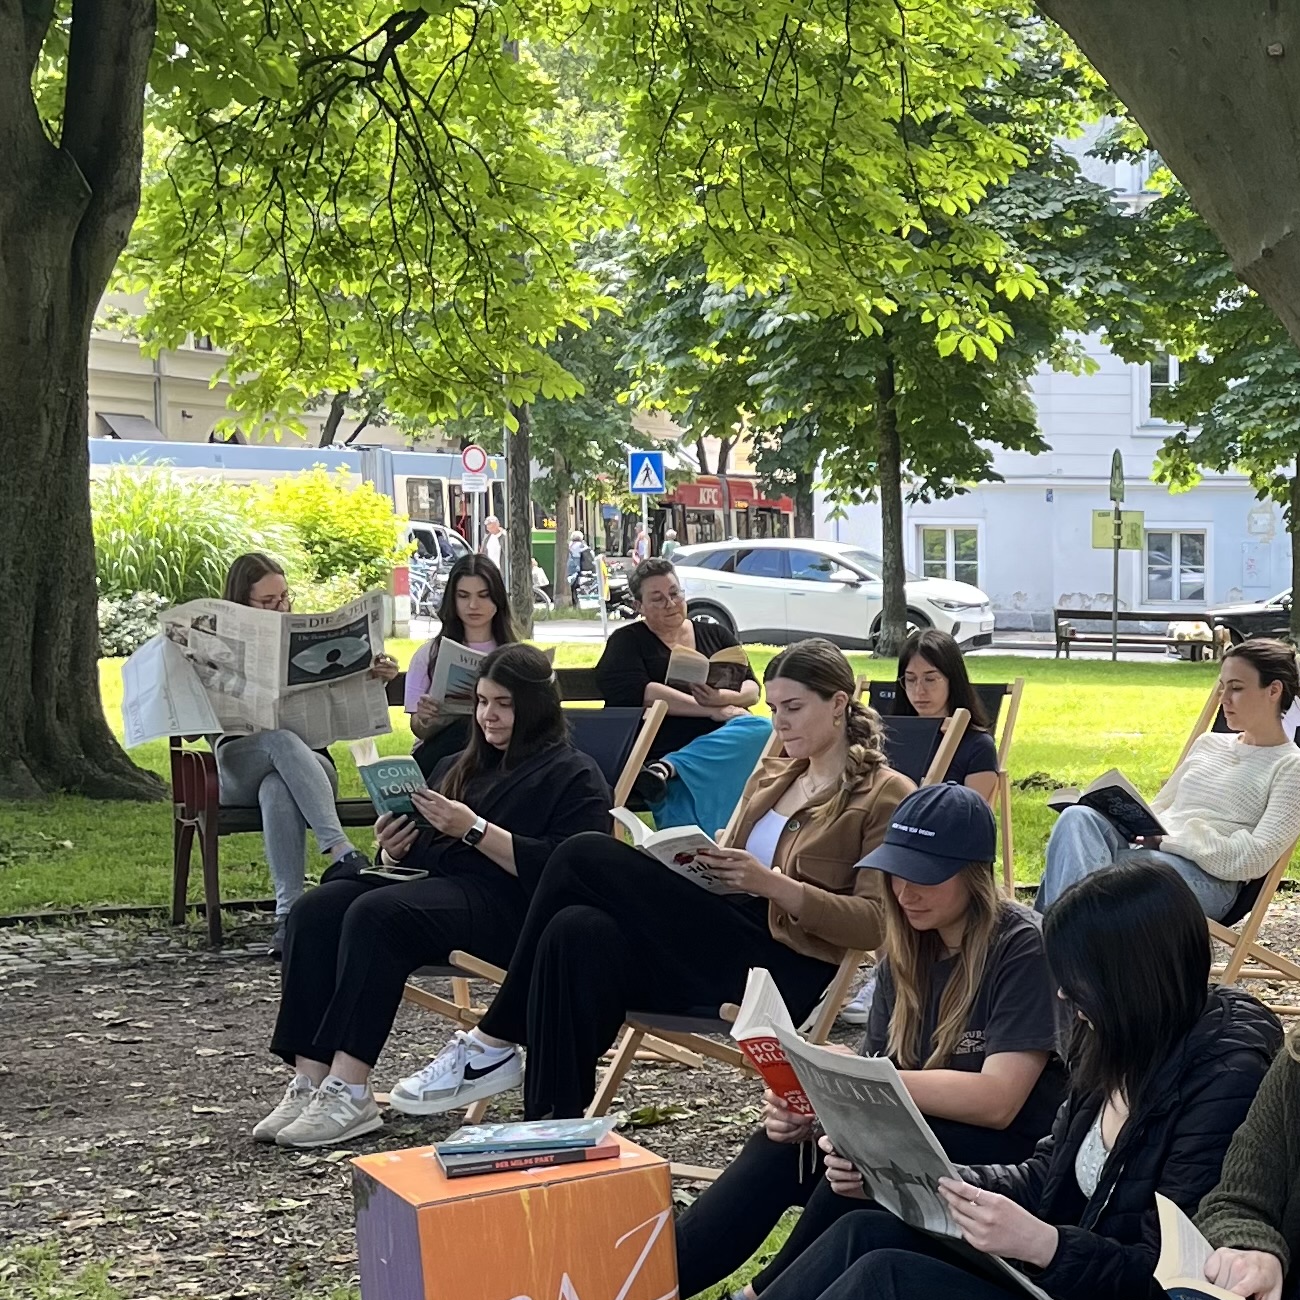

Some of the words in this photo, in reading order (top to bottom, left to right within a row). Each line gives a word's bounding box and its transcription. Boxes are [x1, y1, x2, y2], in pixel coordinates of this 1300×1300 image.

[699, 487, 719, 505] KFC
[308, 616, 333, 629] DIE
[377, 766, 419, 780] COLM
